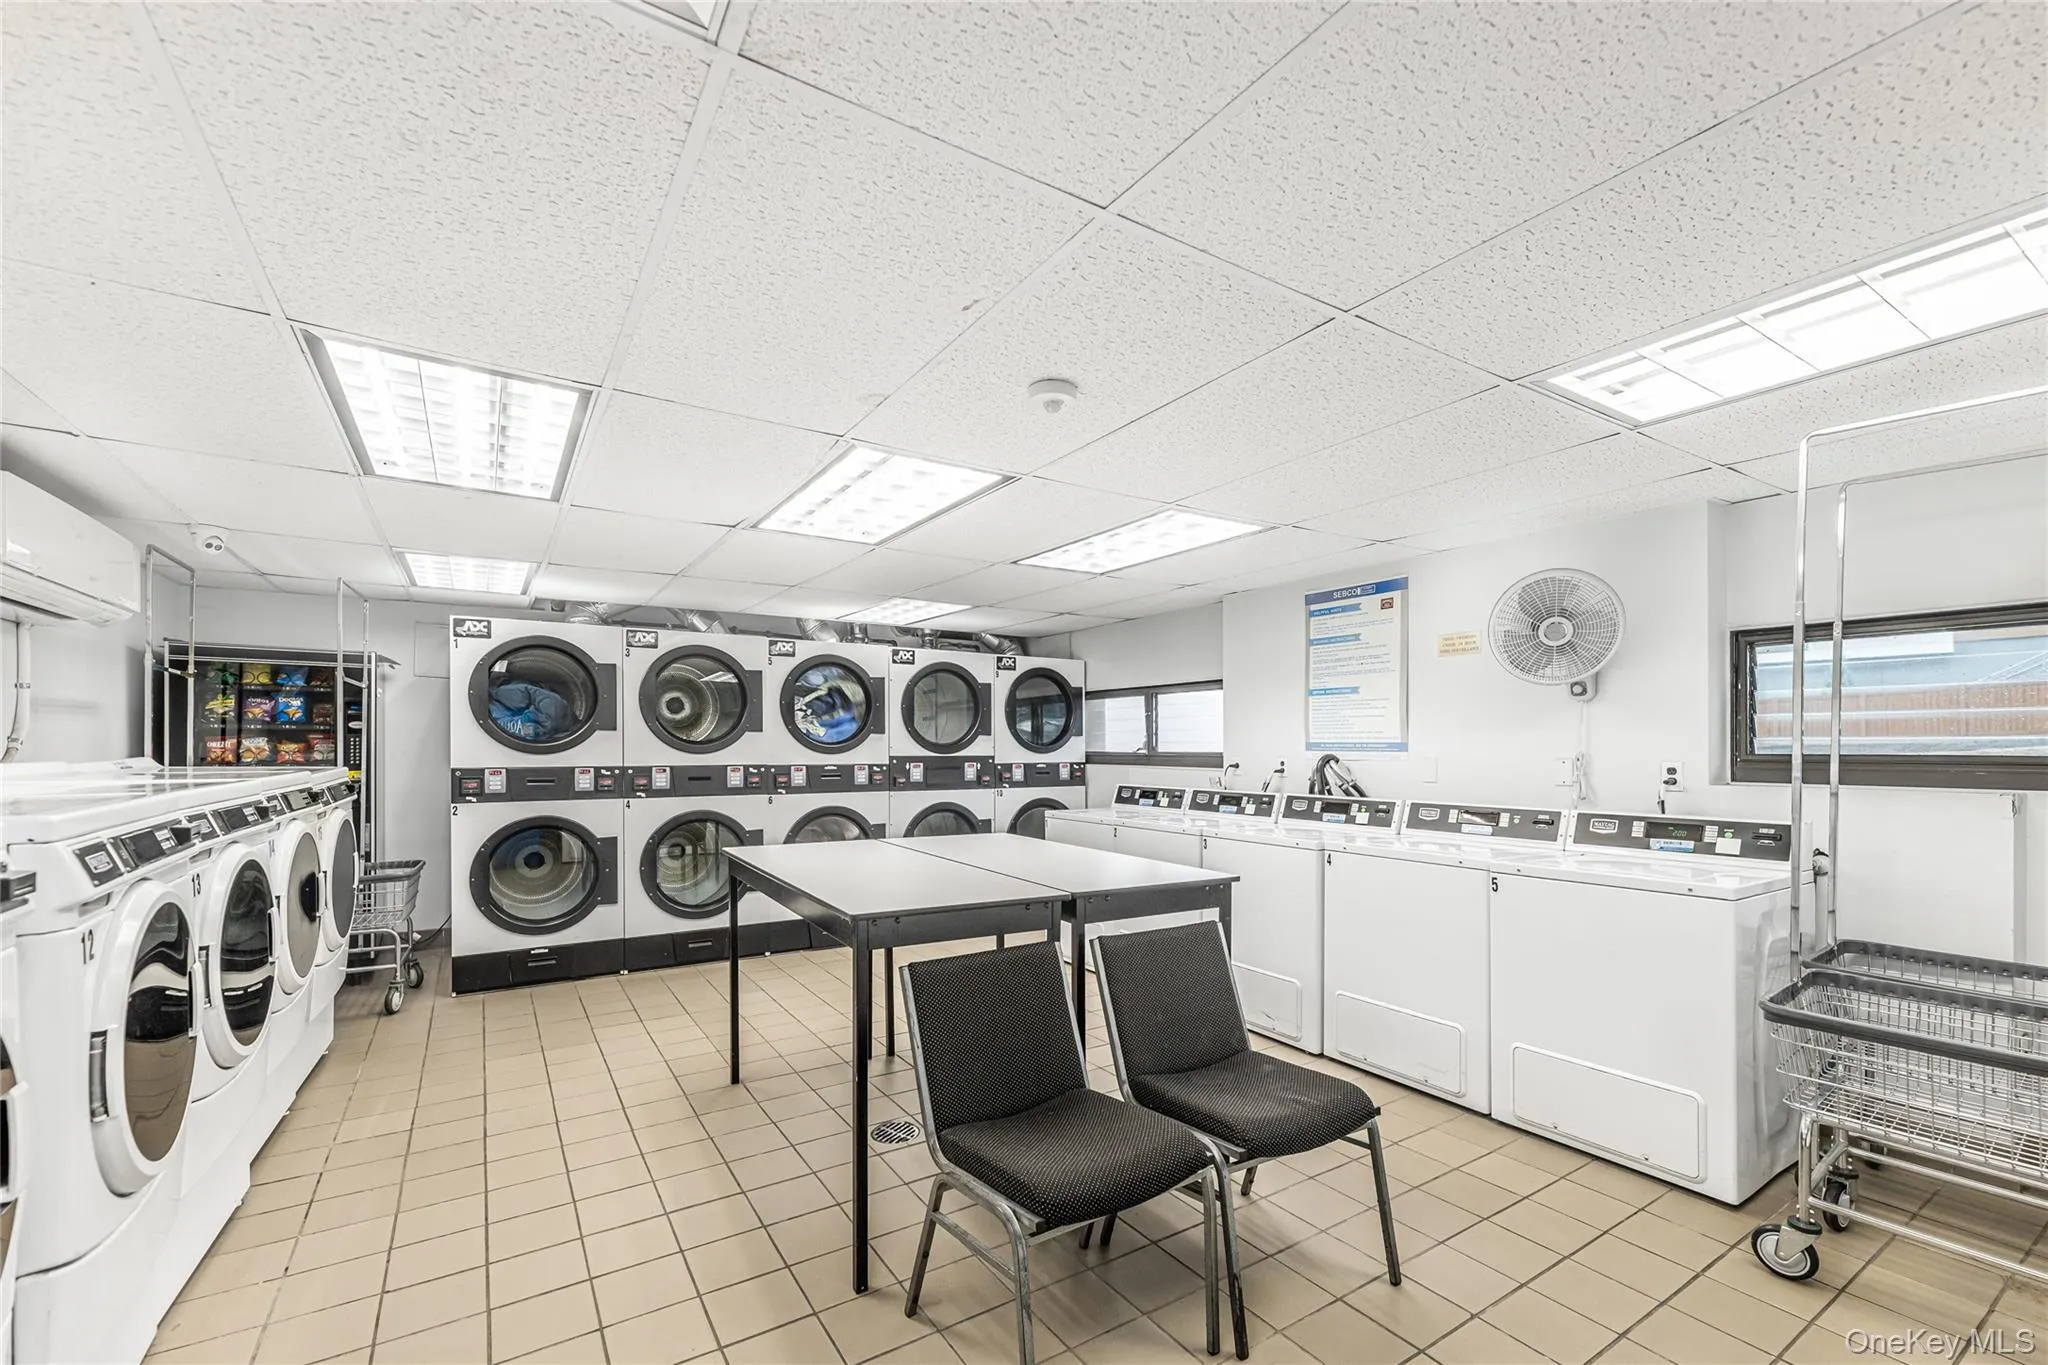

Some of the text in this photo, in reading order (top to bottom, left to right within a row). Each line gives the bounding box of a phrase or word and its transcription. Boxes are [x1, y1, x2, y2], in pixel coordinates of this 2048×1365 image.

[1333, 588, 1357, 599] SEBCO
[463, 620, 488, 632] ADC
[453, 638, 458, 649] 1
[625, 647, 631, 657] 3
[768, 656, 773, 666] 5
[625, 800, 631, 810] 4
[768, 796, 773, 805] 6
[452, 805, 459, 816] 2
[1113, 827, 1118, 838] 2
[1203, 838, 1208, 850] 3
[1326, 853, 1332, 866] 4
[191, 872, 202, 898] 13
[1491, 877, 1499, 893] 5
[80, 928, 95, 965] 12
